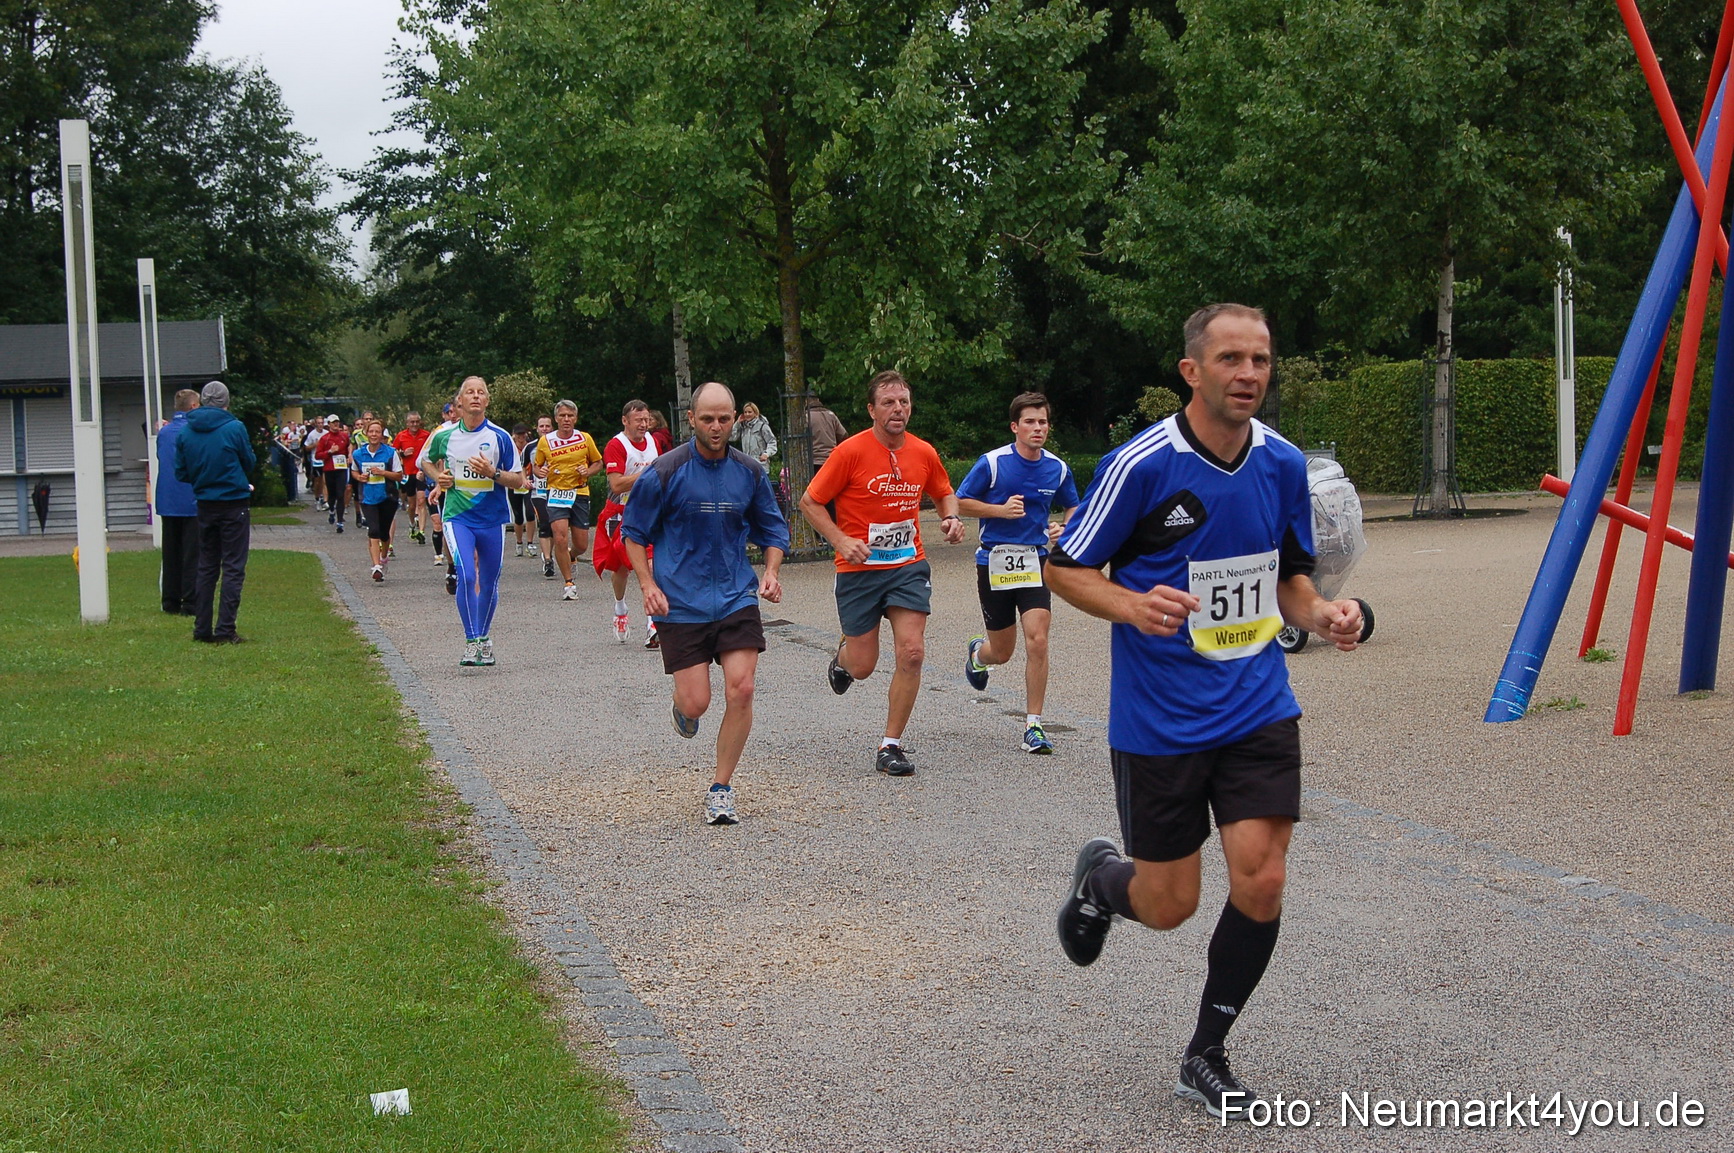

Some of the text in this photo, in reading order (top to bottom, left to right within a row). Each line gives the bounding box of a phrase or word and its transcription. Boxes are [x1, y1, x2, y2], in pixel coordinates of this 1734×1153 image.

[552, 489, 574, 499] 2999
[878, 481, 921, 492] Fischer
[1164, 517, 1195, 527] adidas
[870, 530, 911, 547] 2784
[1005, 555, 1026, 571] 34
[1000, 574, 1032, 584] Christoph
[1192, 564, 1266, 581] PARTL Neumarkt
[1210, 579, 1261, 622] 511
[1215, 629, 1257, 646] Werner
